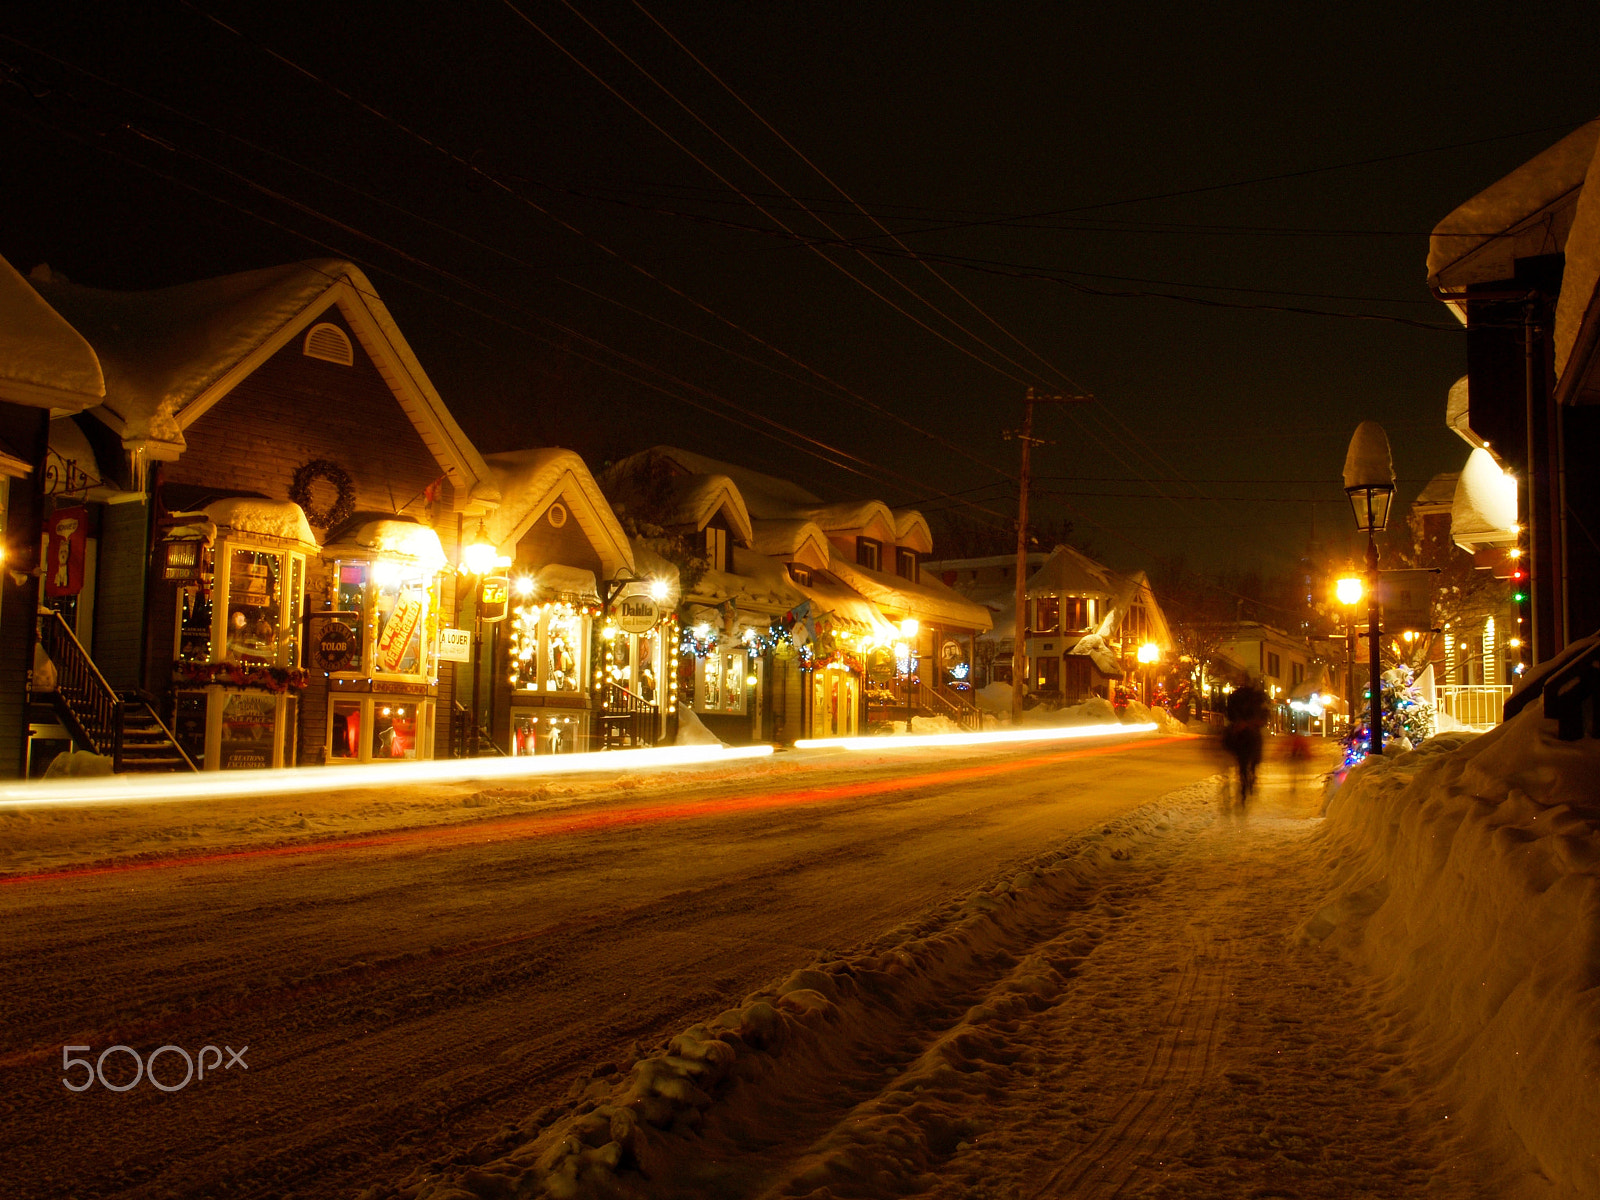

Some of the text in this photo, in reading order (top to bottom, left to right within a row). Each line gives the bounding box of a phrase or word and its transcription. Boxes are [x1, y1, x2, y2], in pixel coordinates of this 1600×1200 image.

[622, 602, 652, 616] Dahlia
[447, 634, 468, 646] LOUER
[321, 642, 347, 651] TOLOB
